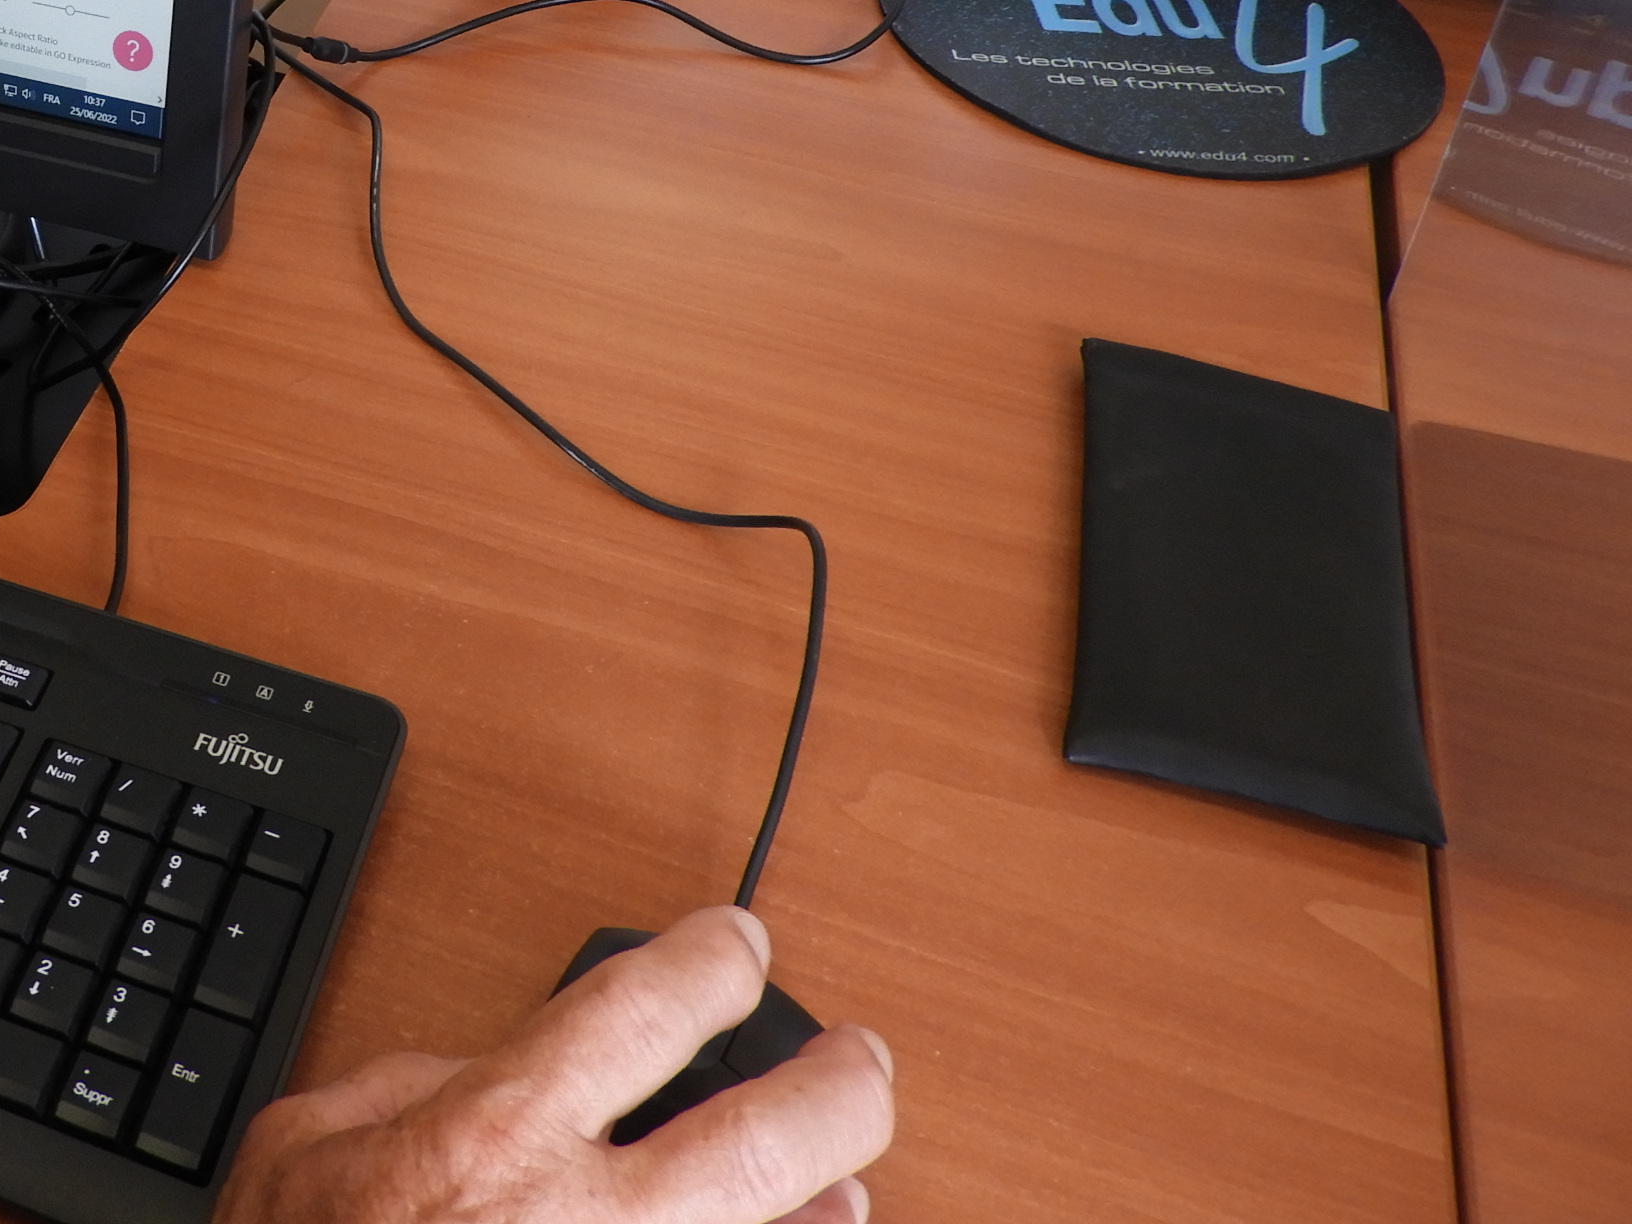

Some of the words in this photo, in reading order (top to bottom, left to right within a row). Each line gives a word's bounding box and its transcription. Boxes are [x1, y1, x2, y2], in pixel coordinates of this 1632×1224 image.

[8, 28, 36, 43] Aspect
[37, 32, 59, 46] Ratio
[9, 40, 43, 56] editable
[44, 47, 51, 57] in
[67, 53, 112, 70] Expression
[951, 49, 1009, 64] Les
[1015, 54, 1215, 76] technologies
[1046, 73, 1087, 86] de
[1092, 75, 1118, 88] la
[1124, 77, 1286, 96] formation
[43, 93, 61, 105] FRA
[83, 95, 106, 108] 10:37
[70, 106, 118, 125] 25/06/2022
[55, 748, 86, 767] Verr
[193, 733, 285, 775] FUJITSU
[45, 764, 77, 783] Num
[171, 1062, 201, 1084] Entr
[72, 1081, 114, 1108] Suppr
